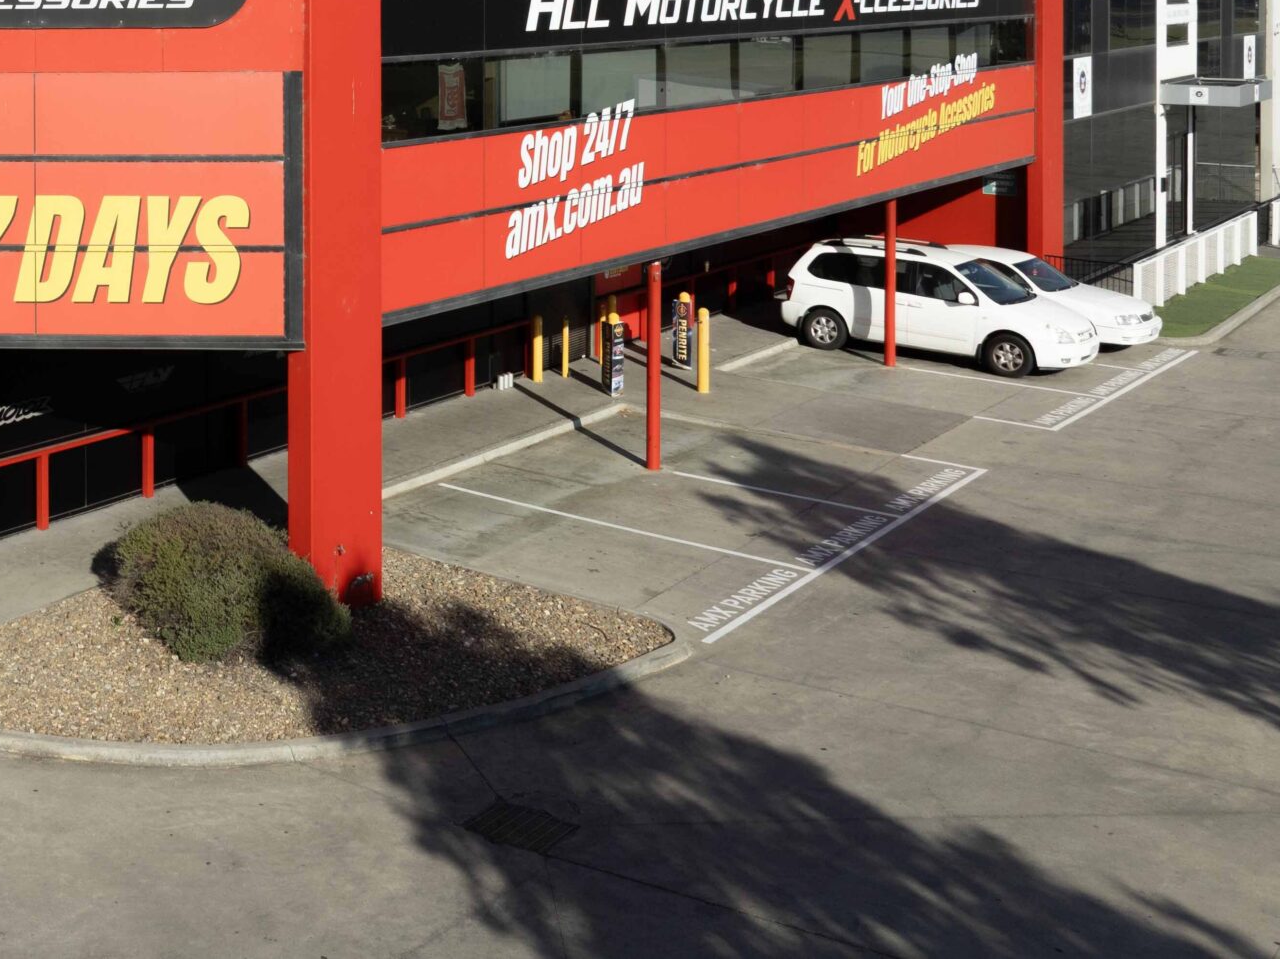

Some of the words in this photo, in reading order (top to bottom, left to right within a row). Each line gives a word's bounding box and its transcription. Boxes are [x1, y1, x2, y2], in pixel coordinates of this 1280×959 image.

[881, 81, 906, 119] Your
[907, 52, 977, 107] One-Stop-Shop
[518, 125, 577, 189] Shop
[581, 98, 635, 165] 24/7
[857, 139, 877, 176] For
[877, 108, 937, 166] Motorcycle
[938, 82, 996, 135] Accessories
[505, 162, 645, 259] amx.com.au
[13, 195, 251, 304] DAYS
[677, 319, 688, 362] PENRITE
[885, 492, 918, 512] AMX
[911, 468, 968, 500] PARKING
[795, 543, 830, 566] AMX
[821, 515, 888, 551] PARKING
[687, 603, 733, 632] AMX
[720, 568, 799, 614] PARKING
